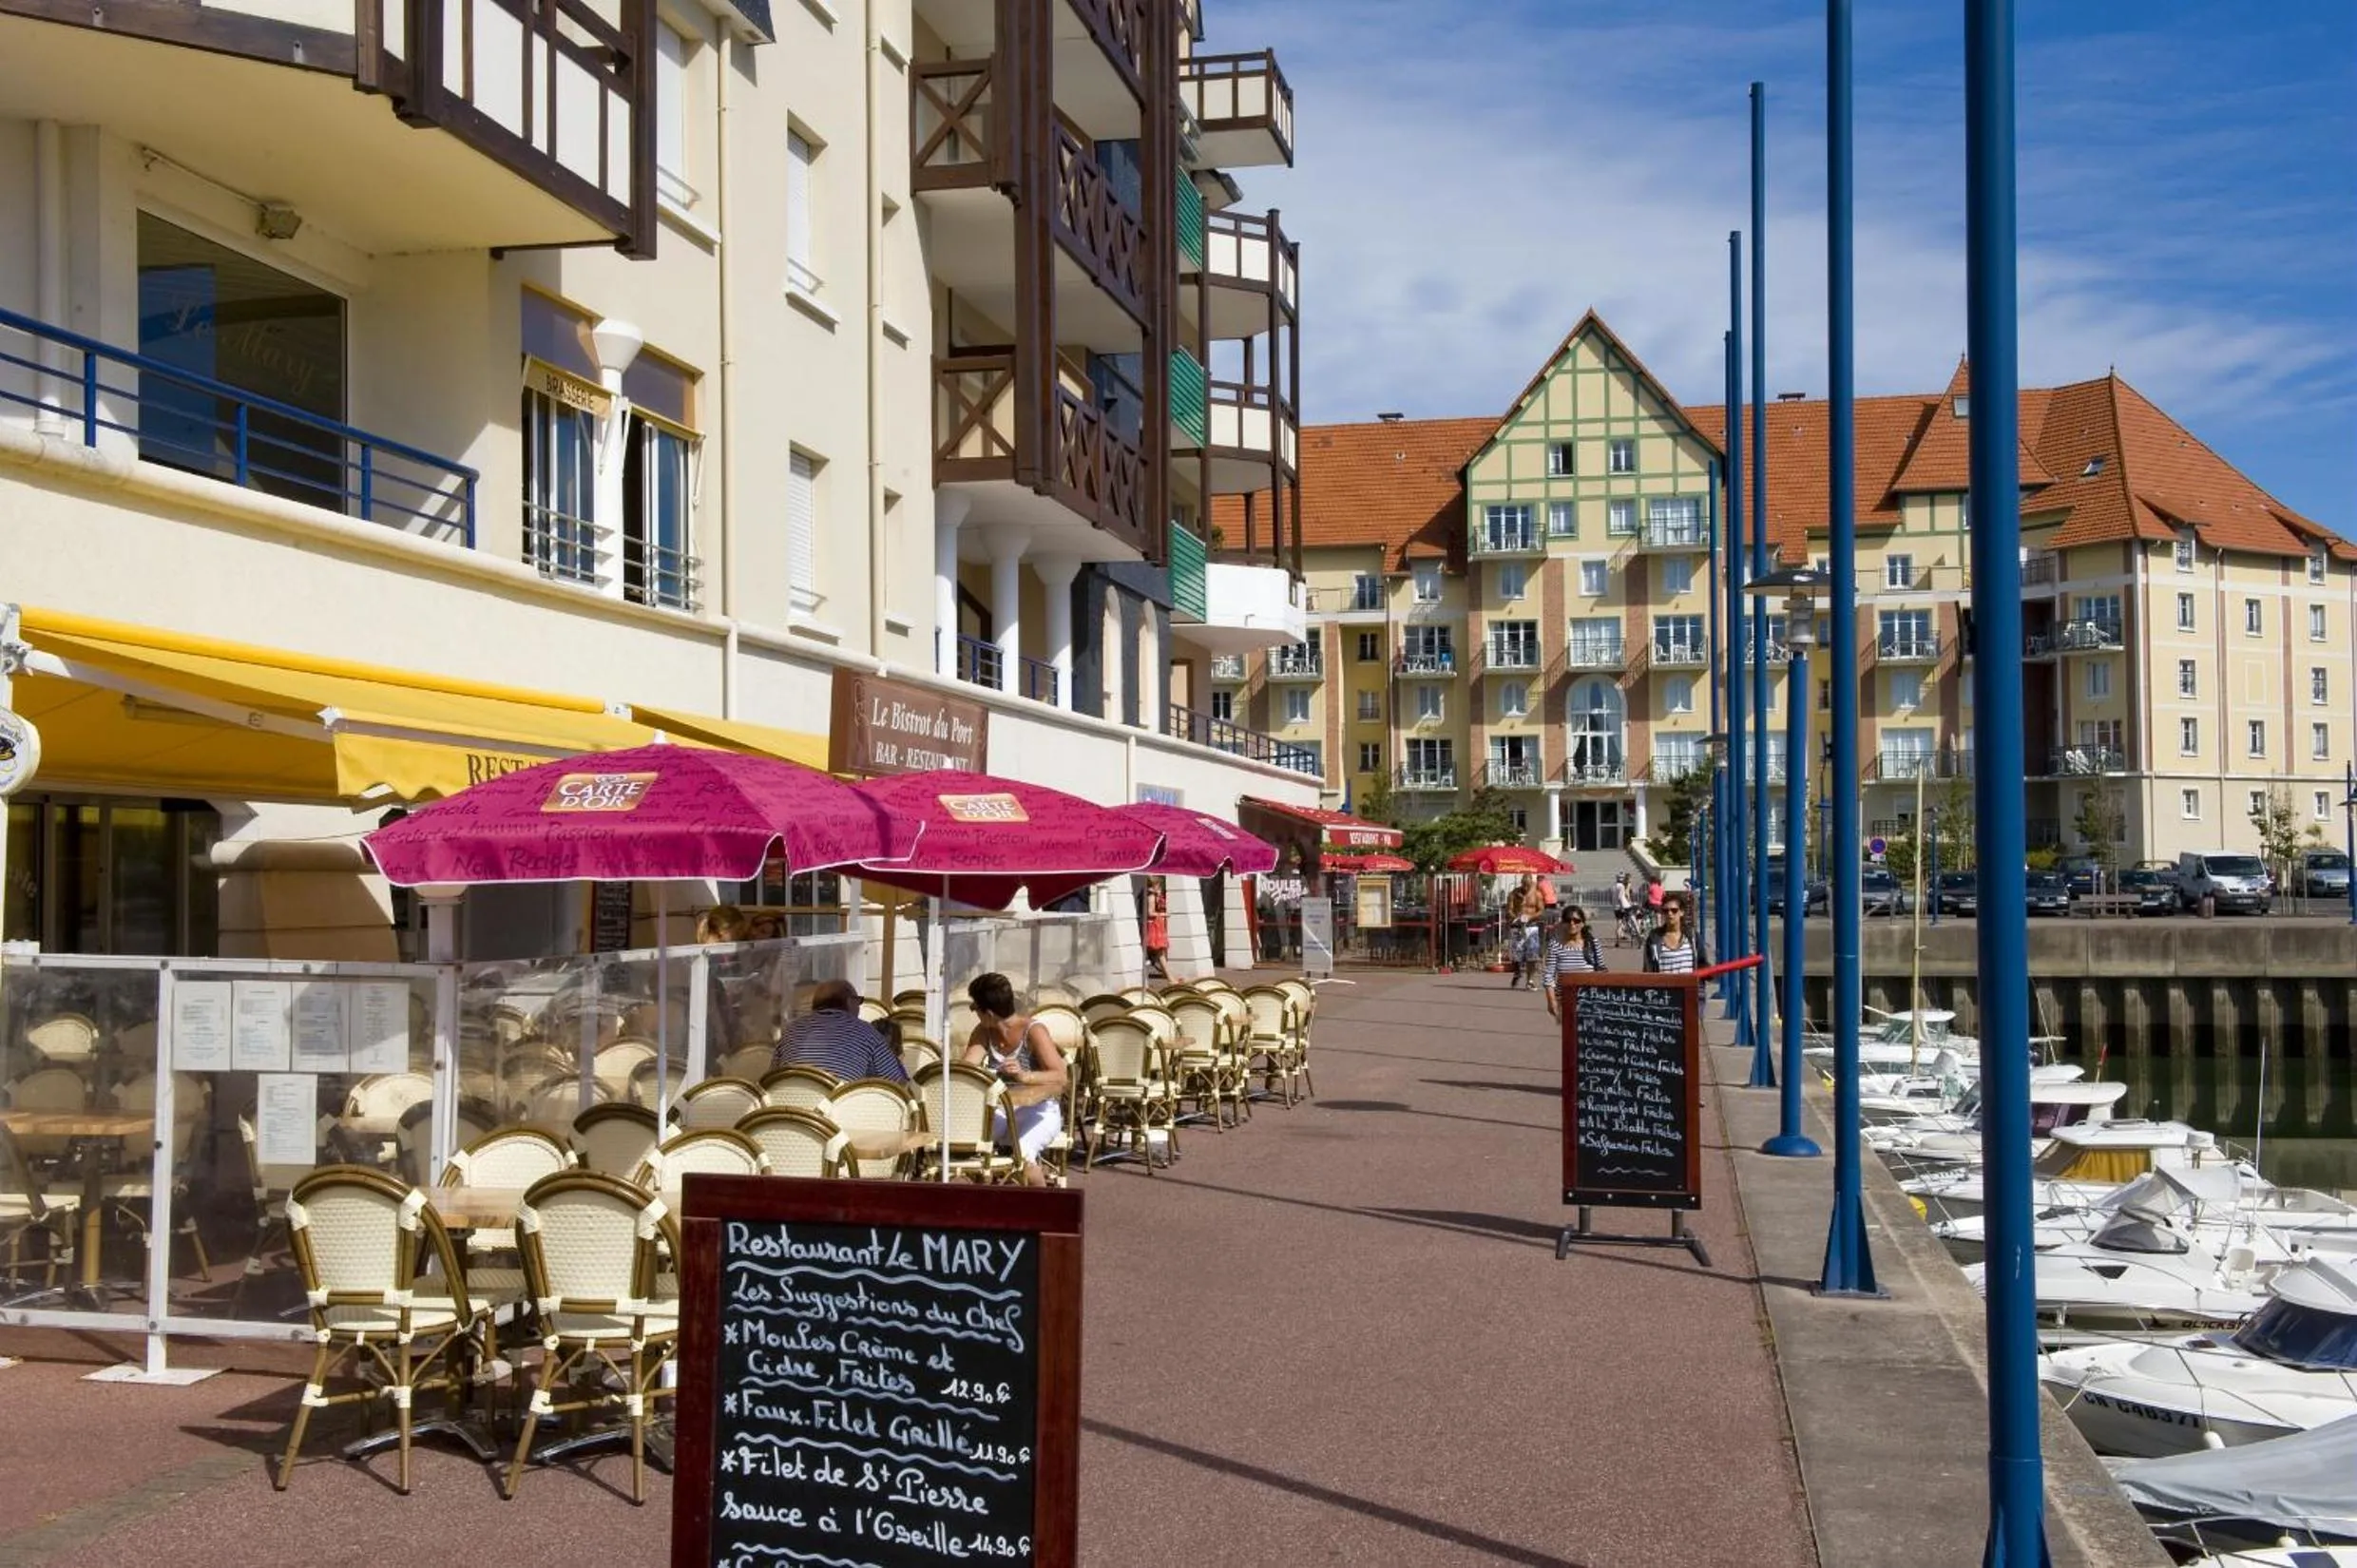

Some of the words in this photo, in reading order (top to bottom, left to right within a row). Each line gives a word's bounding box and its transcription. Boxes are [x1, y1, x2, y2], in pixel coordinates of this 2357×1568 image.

[872, 698, 888, 727] Le
[891, 701, 931, 736] Bistrot
[933, 708, 949, 739] du
[951, 717, 973, 744] Port
[467, 754, 534, 786] REST
[875, 741, 898, 766] BAR
[906, 748, 968, 773] RESTAUANT
[559, 781, 644, 797] CARTE
[949, 800, 1015, 811] CARTE
[727, 1222, 885, 1265] Restaurant
[885, 1232, 918, 1270] Le
[923, 1233, 1025, 1283] MARY
[731, 1272, 772, 1301] Les
[776, 1276, 919, 1322] Suggestions
[926, 1301, 961, 1325] du
[742, 1319, 836, 1352] Moules
[840, 1330, 918, 1364] Crème
[927, 1343, 955, 1372] et
[839, 1359, 915, 1394] Frites
[889, 1415, 973, 1455] Grillé
[738, 1445, 807, 1480] Filet
[814, 1456, 848, 1486] de
[889, 1468, 988, 1515] Pierre
[818, 1506, 841, 1532] à
